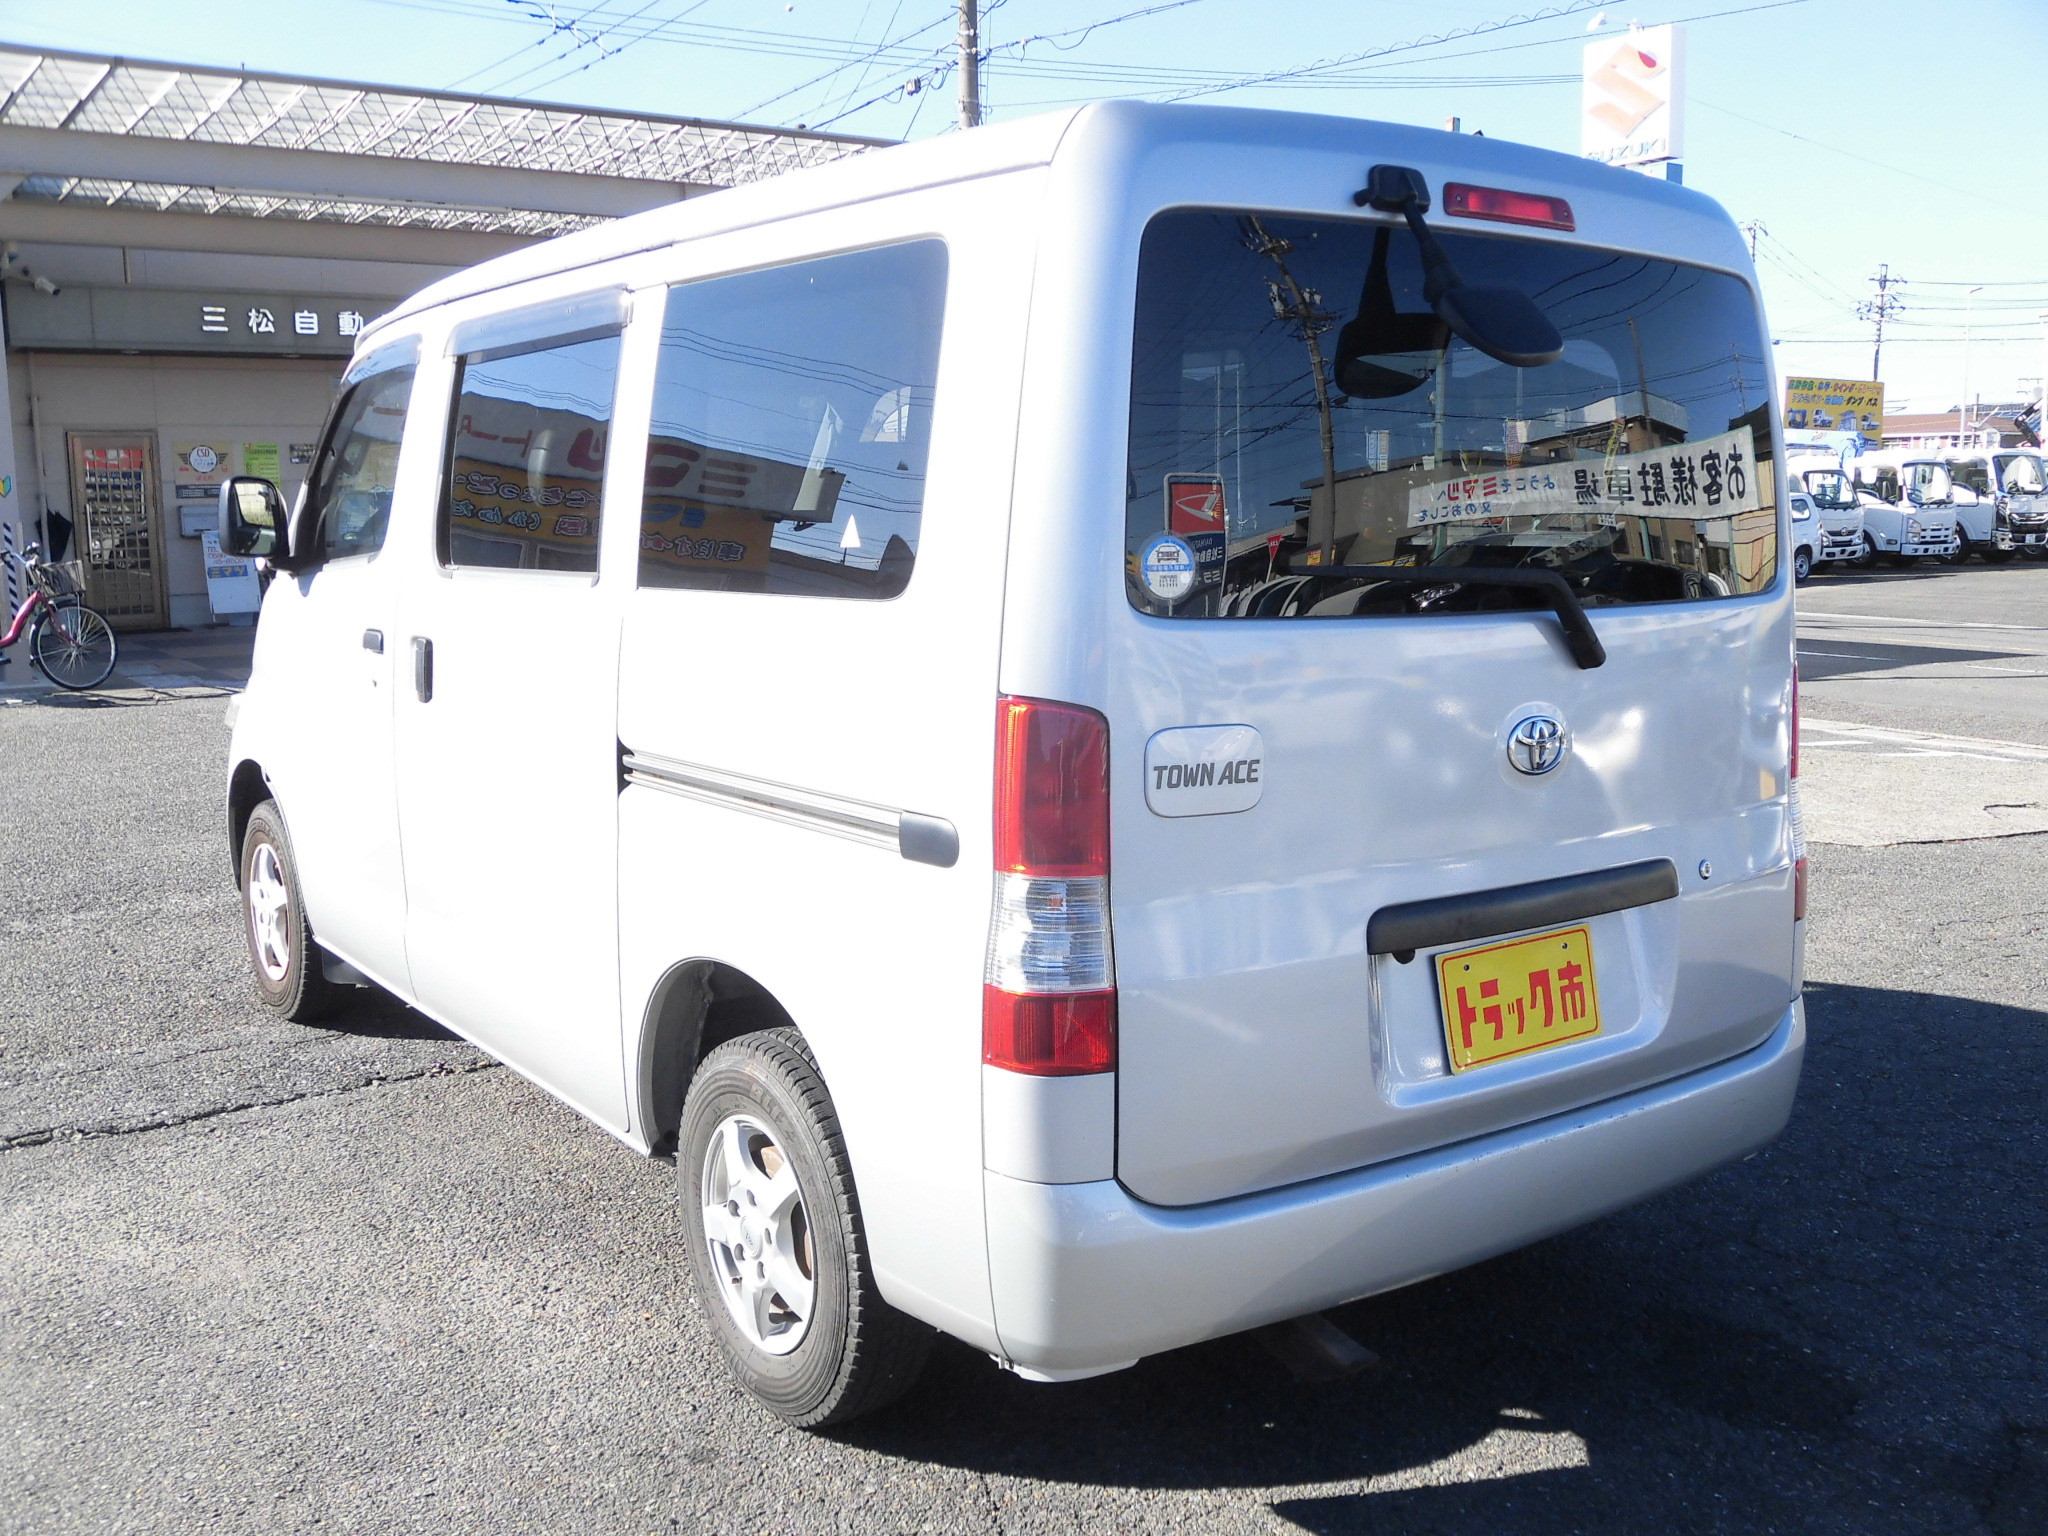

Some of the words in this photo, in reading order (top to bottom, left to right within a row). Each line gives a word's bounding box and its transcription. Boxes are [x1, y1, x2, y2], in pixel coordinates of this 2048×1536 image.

[1153, 763, 1215, 790] TOWN
[1218, 759, 1260, 786] ACE
[1456, 960, 1587, 1049] トラック市
